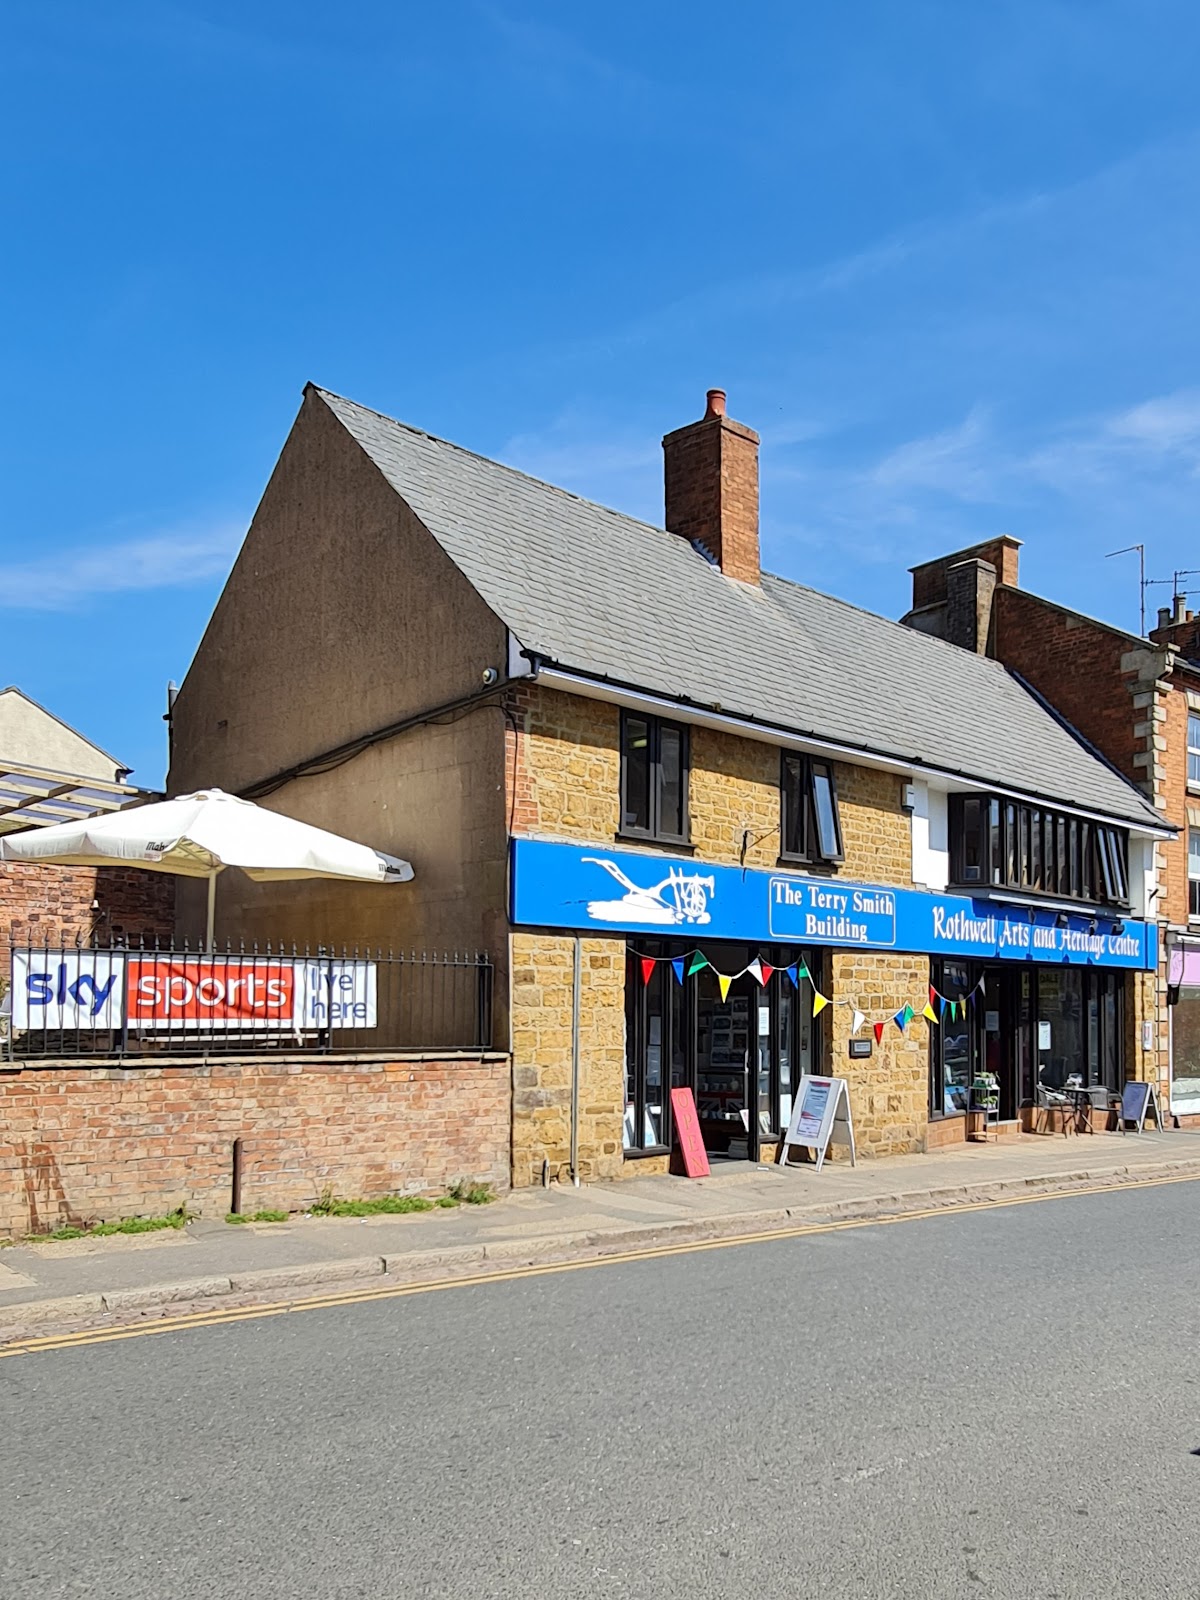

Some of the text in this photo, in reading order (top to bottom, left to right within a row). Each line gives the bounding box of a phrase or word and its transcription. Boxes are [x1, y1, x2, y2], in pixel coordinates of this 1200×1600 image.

[773, 882, 893, 915] The Terry Smith
[806, 913, 868, 942] Building
[932, 905, 996, 944] Rothwell
[999, 914, 1029, 948] Arts
[1033, 922, 1056, 949] and
[1108, 933, 1139, 957] Centre
[25, 962, 287, 1016] sky sports
[311, 967, 353, 991] live
[311, 995, 367, 1019] here
[677, 1091, 705, 1174] OPEN
